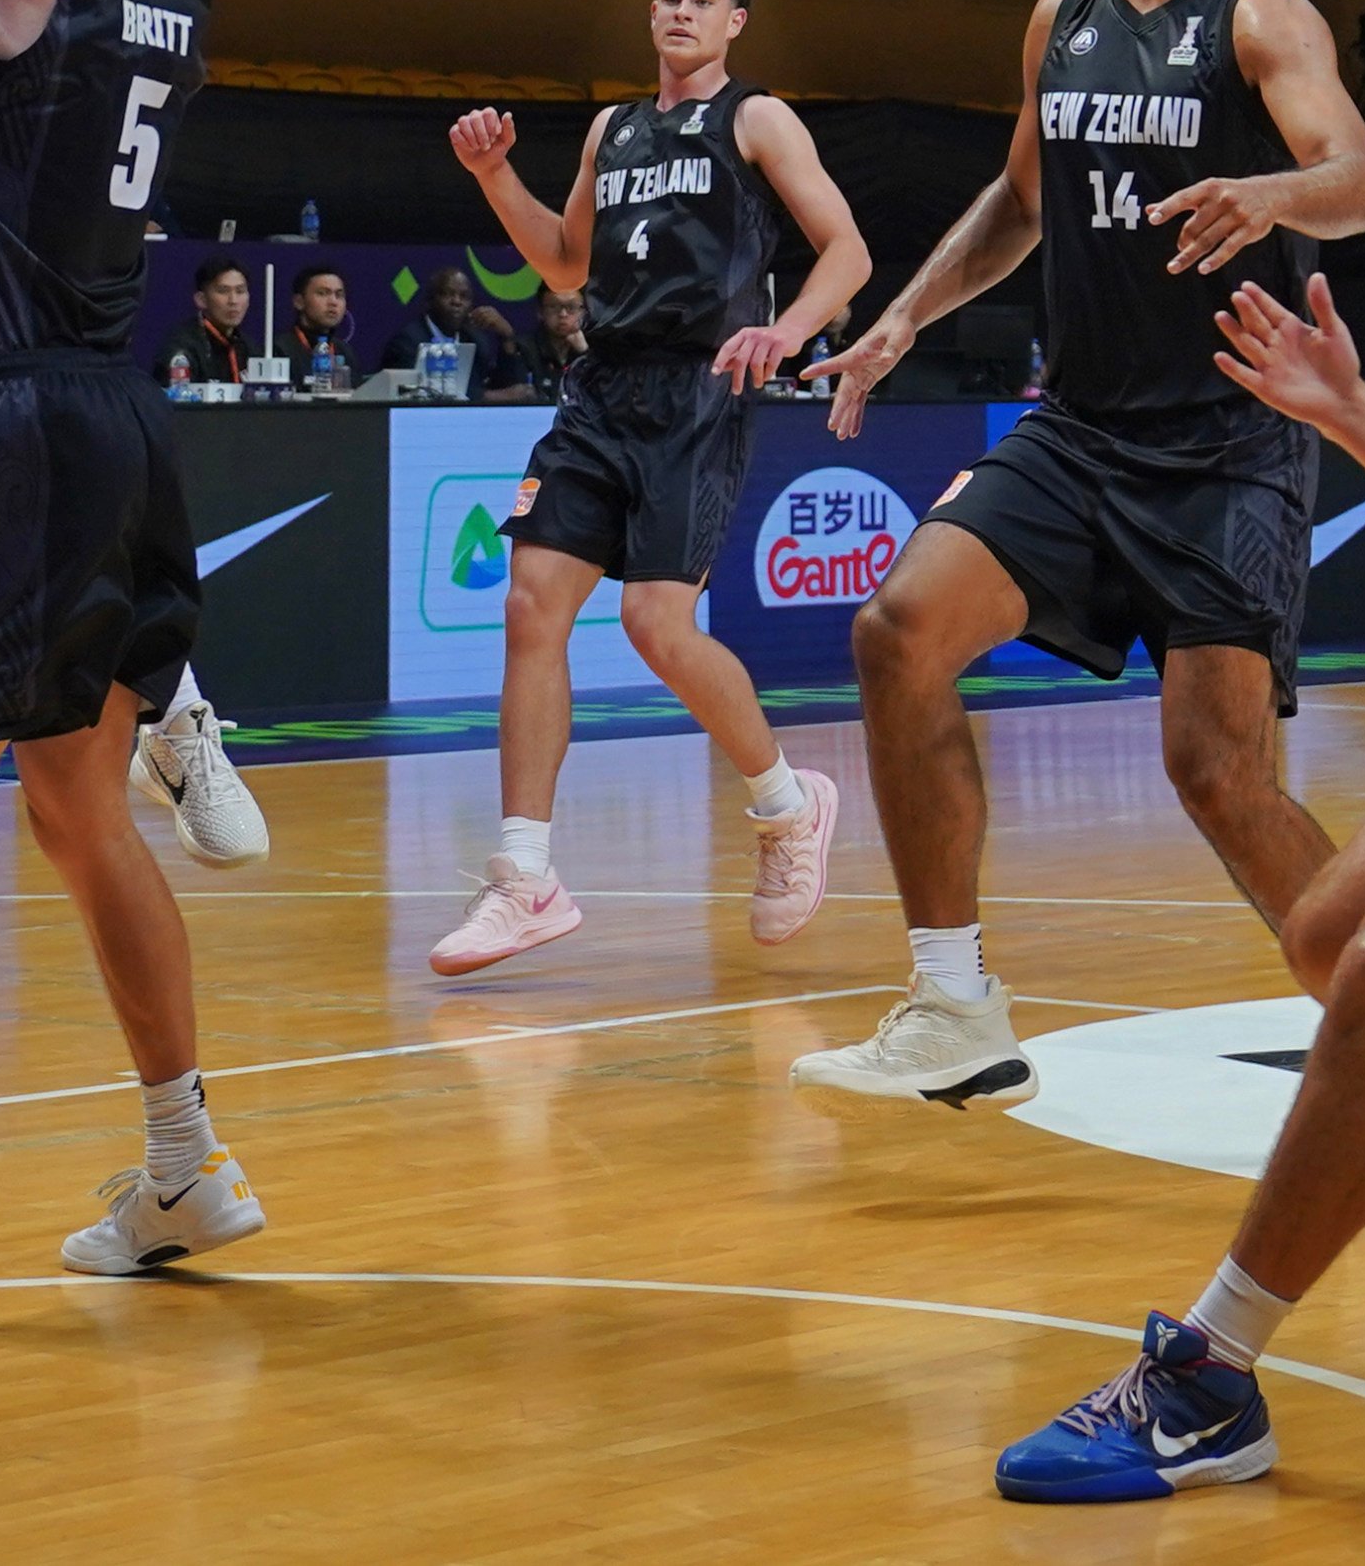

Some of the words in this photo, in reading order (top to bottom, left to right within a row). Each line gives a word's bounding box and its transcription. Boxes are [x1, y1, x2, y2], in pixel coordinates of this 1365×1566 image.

[109, 75, 173, 211] 5
[1085, 93, 1202, 148] ZEALAND
[628, 157, 712, 204] ZEALAND
[1088, 170, 1141, 230] 14
[626, 219, 650, 260] 4
[788, 490, 887, 535] 百岁山
[767, 533, 897, 599] Gante
